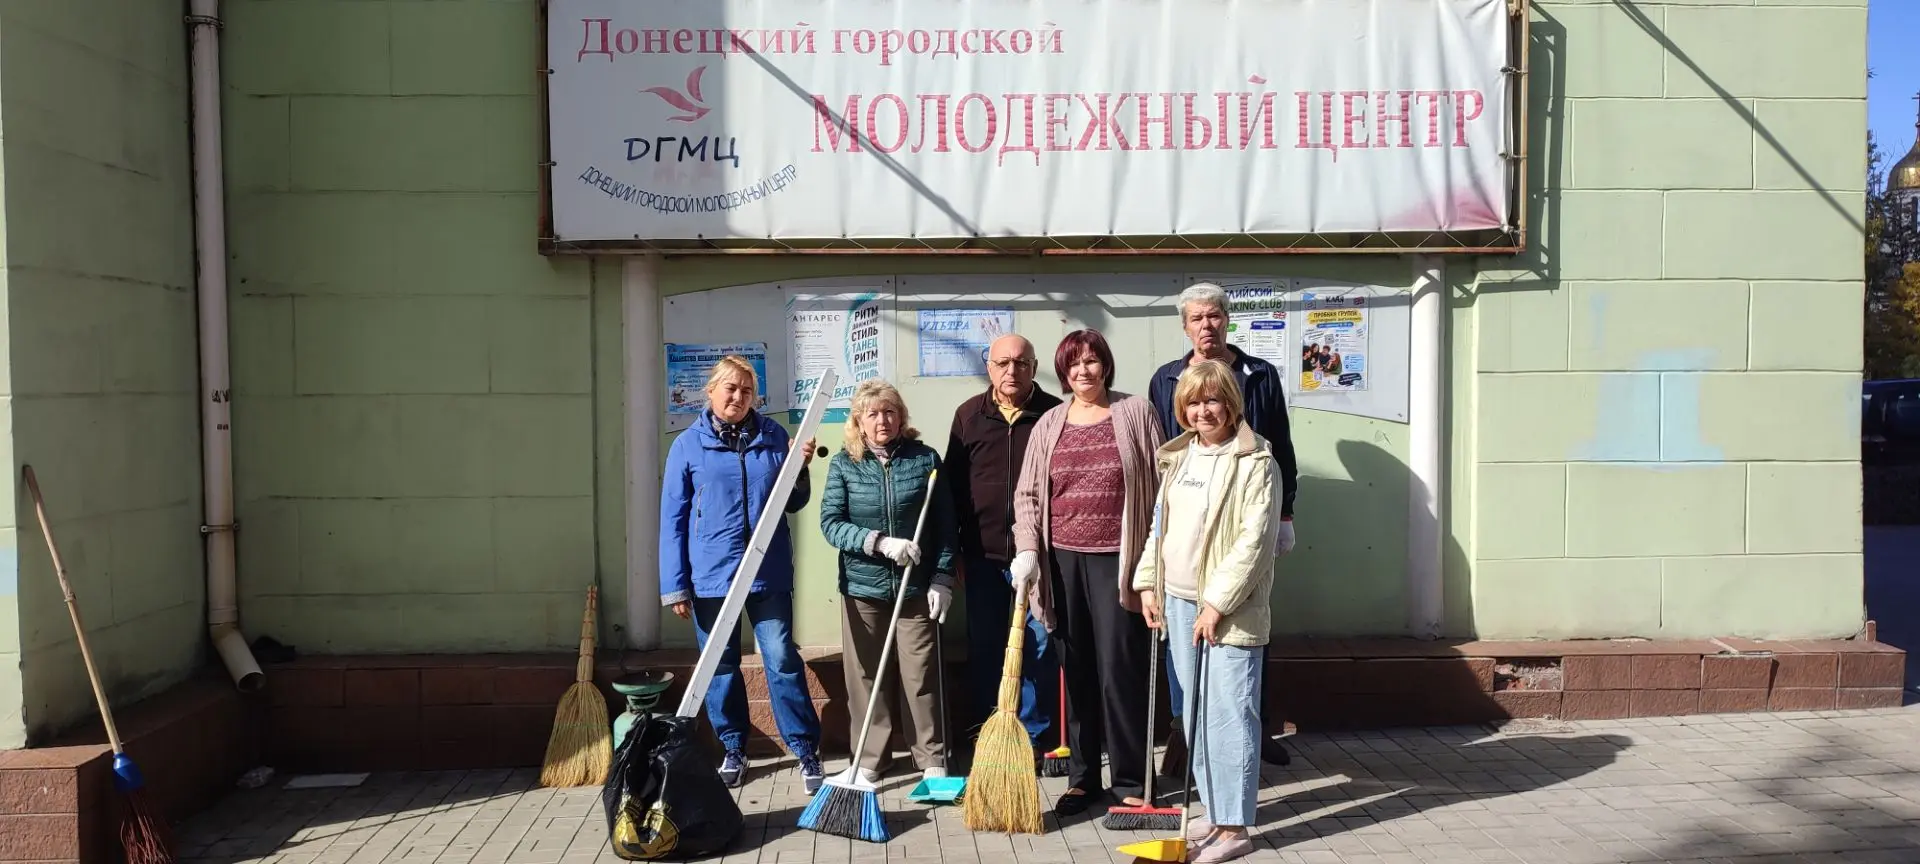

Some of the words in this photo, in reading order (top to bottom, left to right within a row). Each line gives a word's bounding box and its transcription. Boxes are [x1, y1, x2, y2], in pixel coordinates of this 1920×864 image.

[577, 18, 815, 62] Донецкий
[831, 21, 1064, 65] городской
[810, 74, 1278, 167] МОЛОДЕЖНЫЙ
[1294, 89, 1484, 163] ЦЕНТР
[578, 165, 637, 204] ДОНЕЦКИЙ
[635, 190, 694, 215] ГОРОДСКОЙ
[696, 179, 771, 212] МОЛОДЕЖНЫЙ
[768, 164, 797, 192] ЦЕНТР
[1258, 298, 1282, 310] CLUB
[791, 314, 841, 323] АНТАРЕС
[854, 305, 879, 321] РИТМ
[851, 325, 878, 342] СТИЛЬ
[920, 320, 971, 331] УЛЬТРА
[852, 337, 878, 353] ТАНЕЦ
[854, 349, 878, 364] РИТМ
